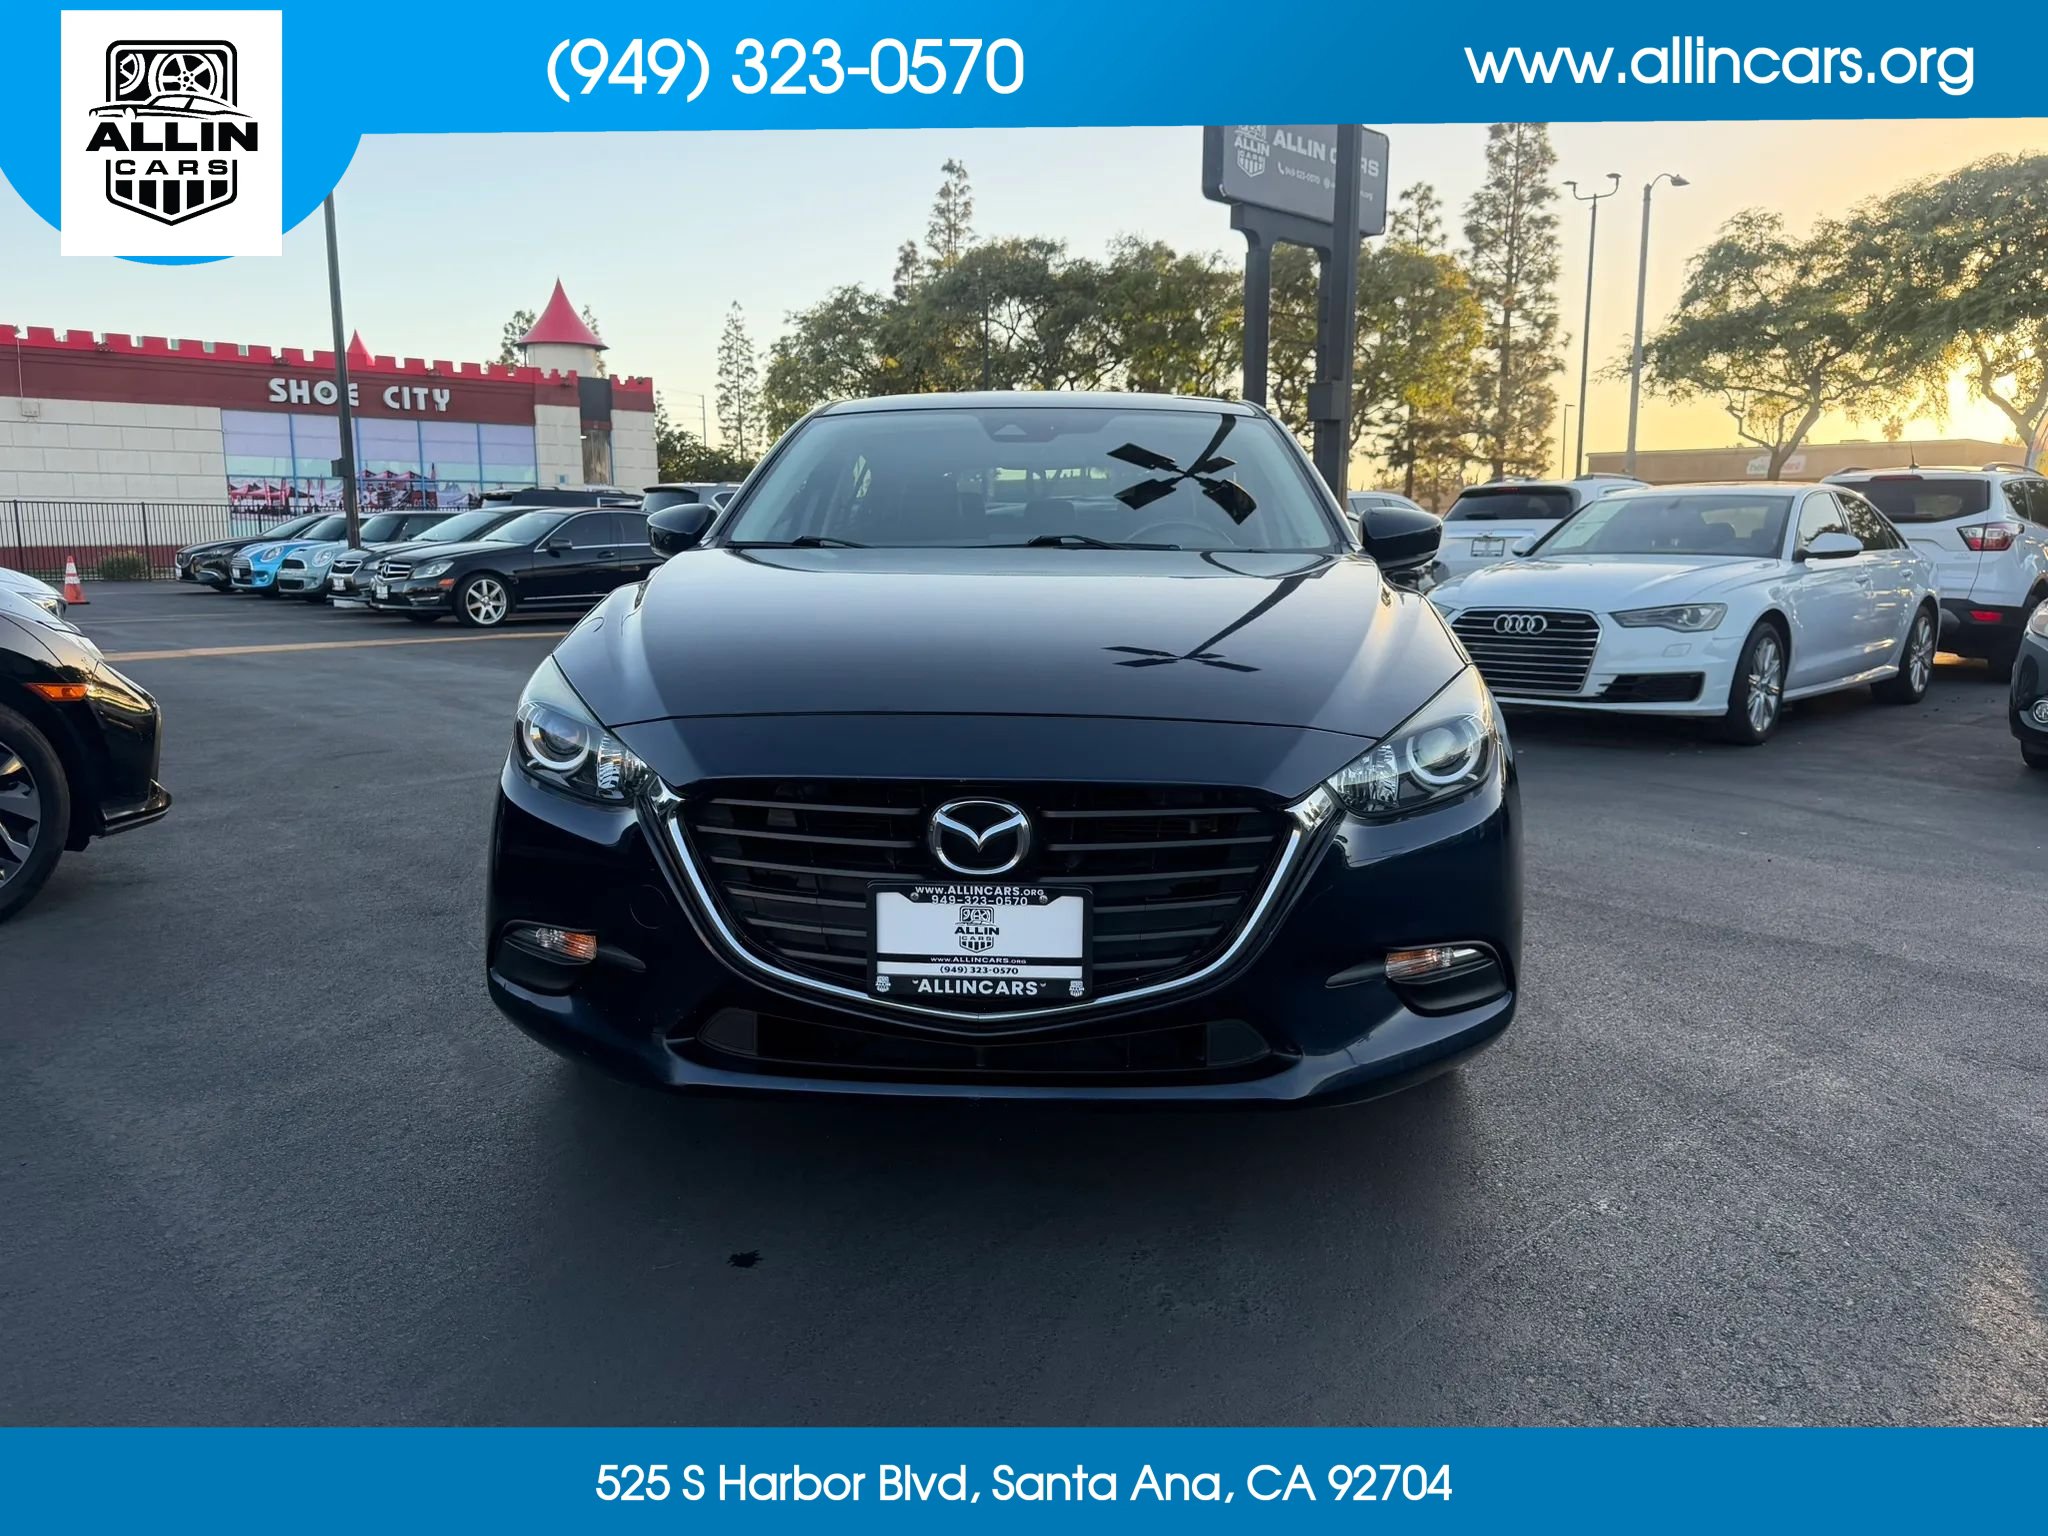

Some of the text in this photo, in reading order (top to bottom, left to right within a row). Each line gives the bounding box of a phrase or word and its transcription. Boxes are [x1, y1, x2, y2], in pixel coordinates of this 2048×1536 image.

[1234, 135, 1270, 158] ALLIN
[1273, 128, 1326, 161] ALLIN
[268, 377, 450, 412] SHOE CITY
[931, 895, 1028, 906] 949-323-0570
[954, 926, 1000, 936] ALLIN
[939, 965, 1019, 975] (949) 323-0570
[917, 978, 1038, 996] ALLINCARS
